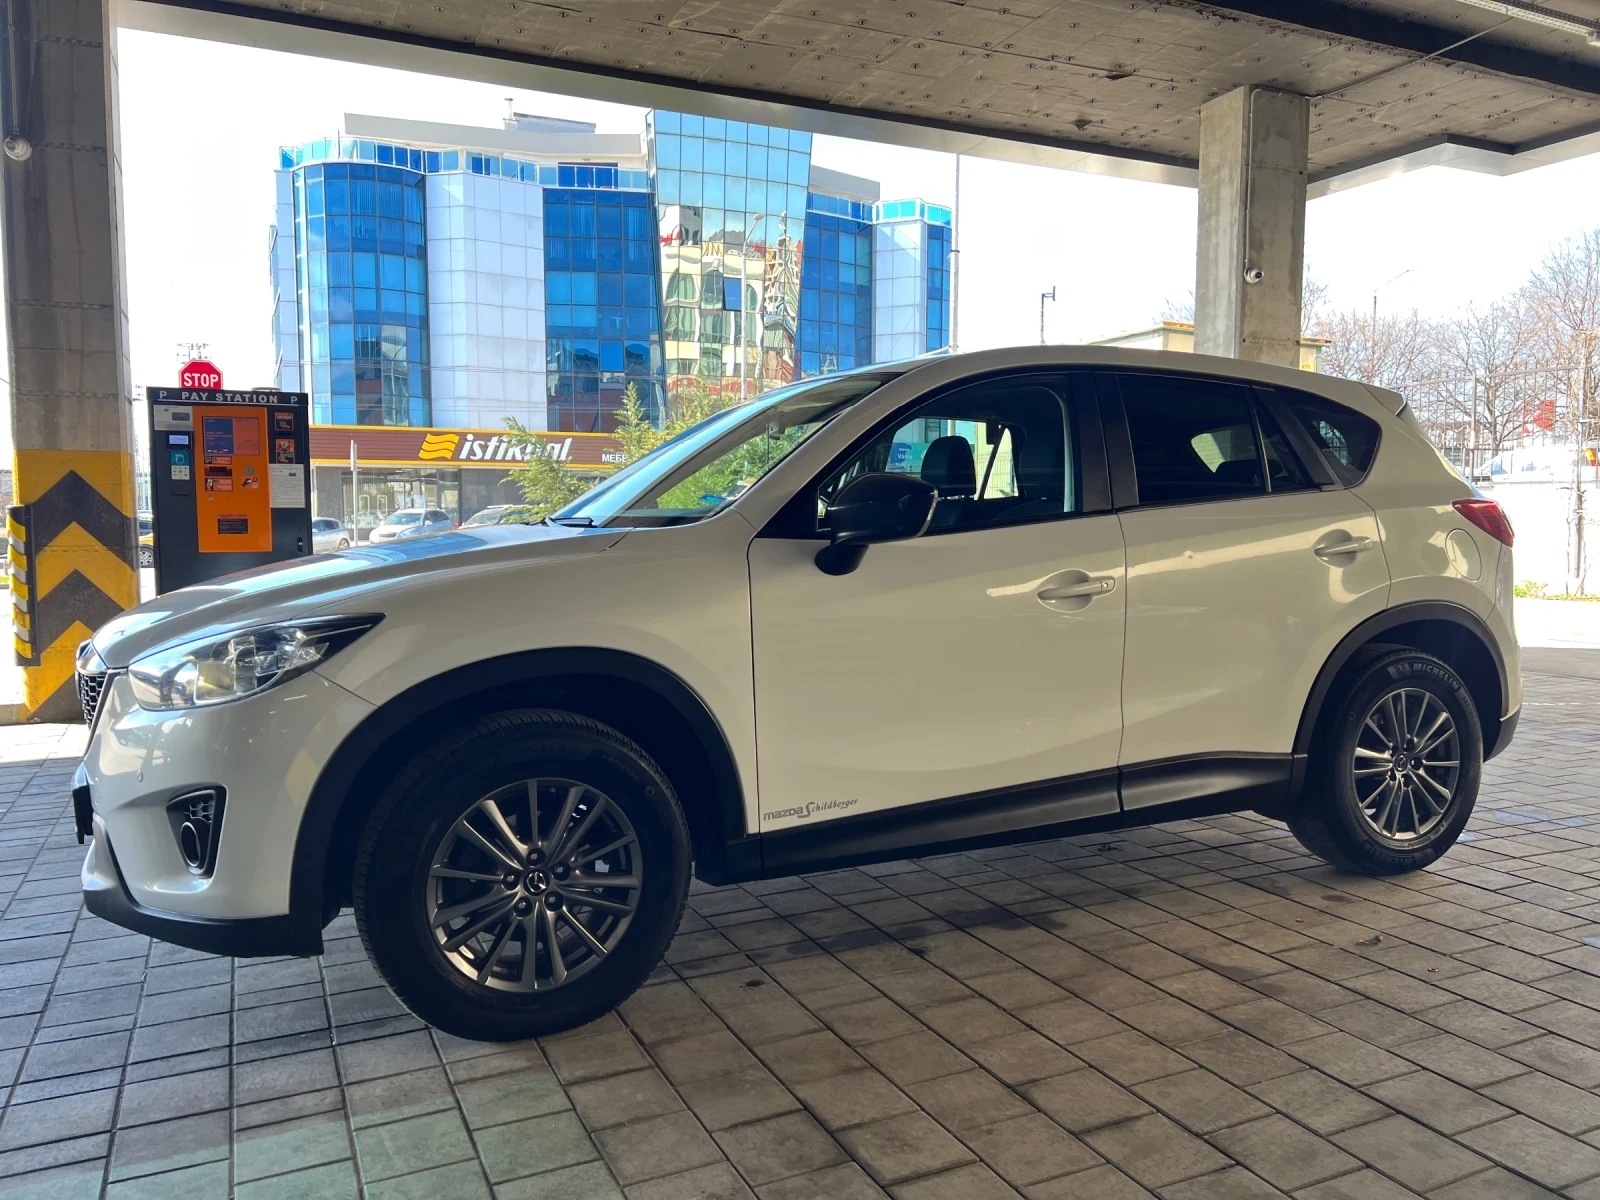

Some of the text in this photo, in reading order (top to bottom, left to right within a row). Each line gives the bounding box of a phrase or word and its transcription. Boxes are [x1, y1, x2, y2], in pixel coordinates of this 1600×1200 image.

[183, 372, 219, 388] STOP
[159, 390, 298, 405] P PAY STATION P
[1412, 662, 1460, 691] MICHELIN
[797, 798, 858, 819] Schildberger
